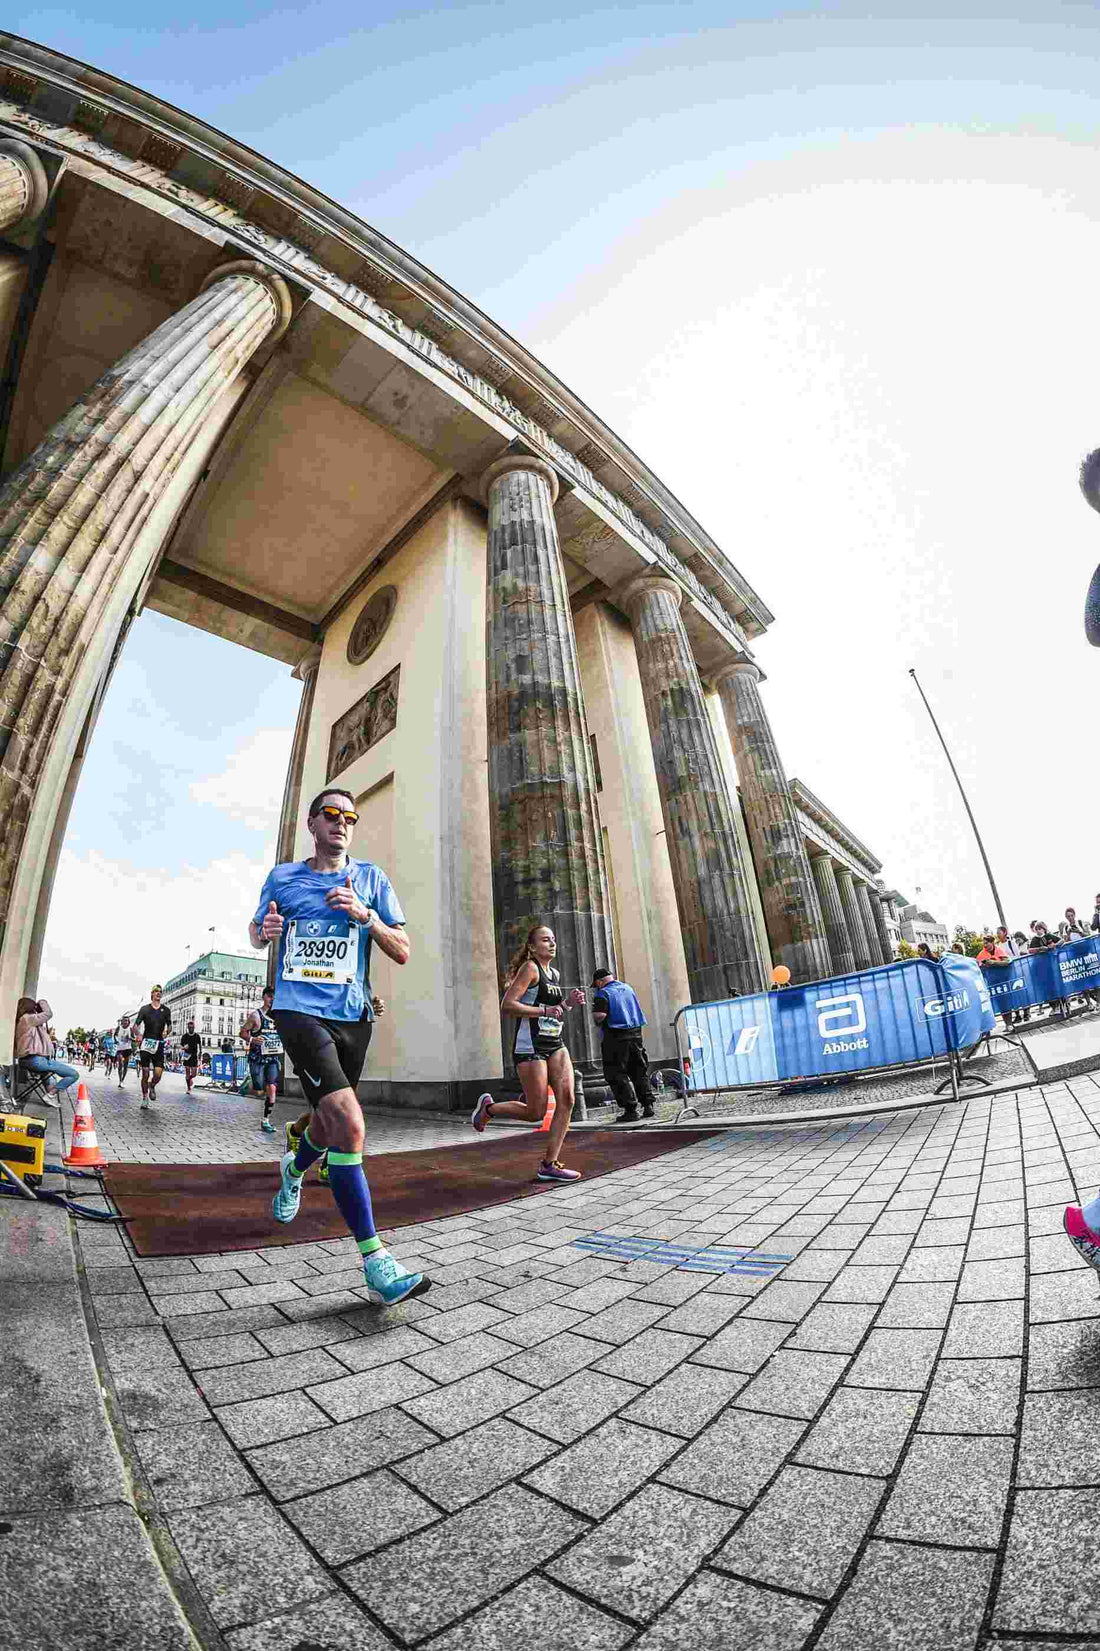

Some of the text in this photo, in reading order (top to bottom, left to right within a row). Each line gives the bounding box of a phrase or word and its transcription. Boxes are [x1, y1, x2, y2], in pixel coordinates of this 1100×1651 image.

[295, 940, 348, 960] 28990
[303, 958, 335, 968] Jonathan
[1059, 957, 1083, 971] BMW
[1061, 965, 1086, 977] BERLIN
[990, 984, 1008, 996] iti
[924, 993, 962, 1016] Giti
[822, 1037, 869, 1056] Abbott
